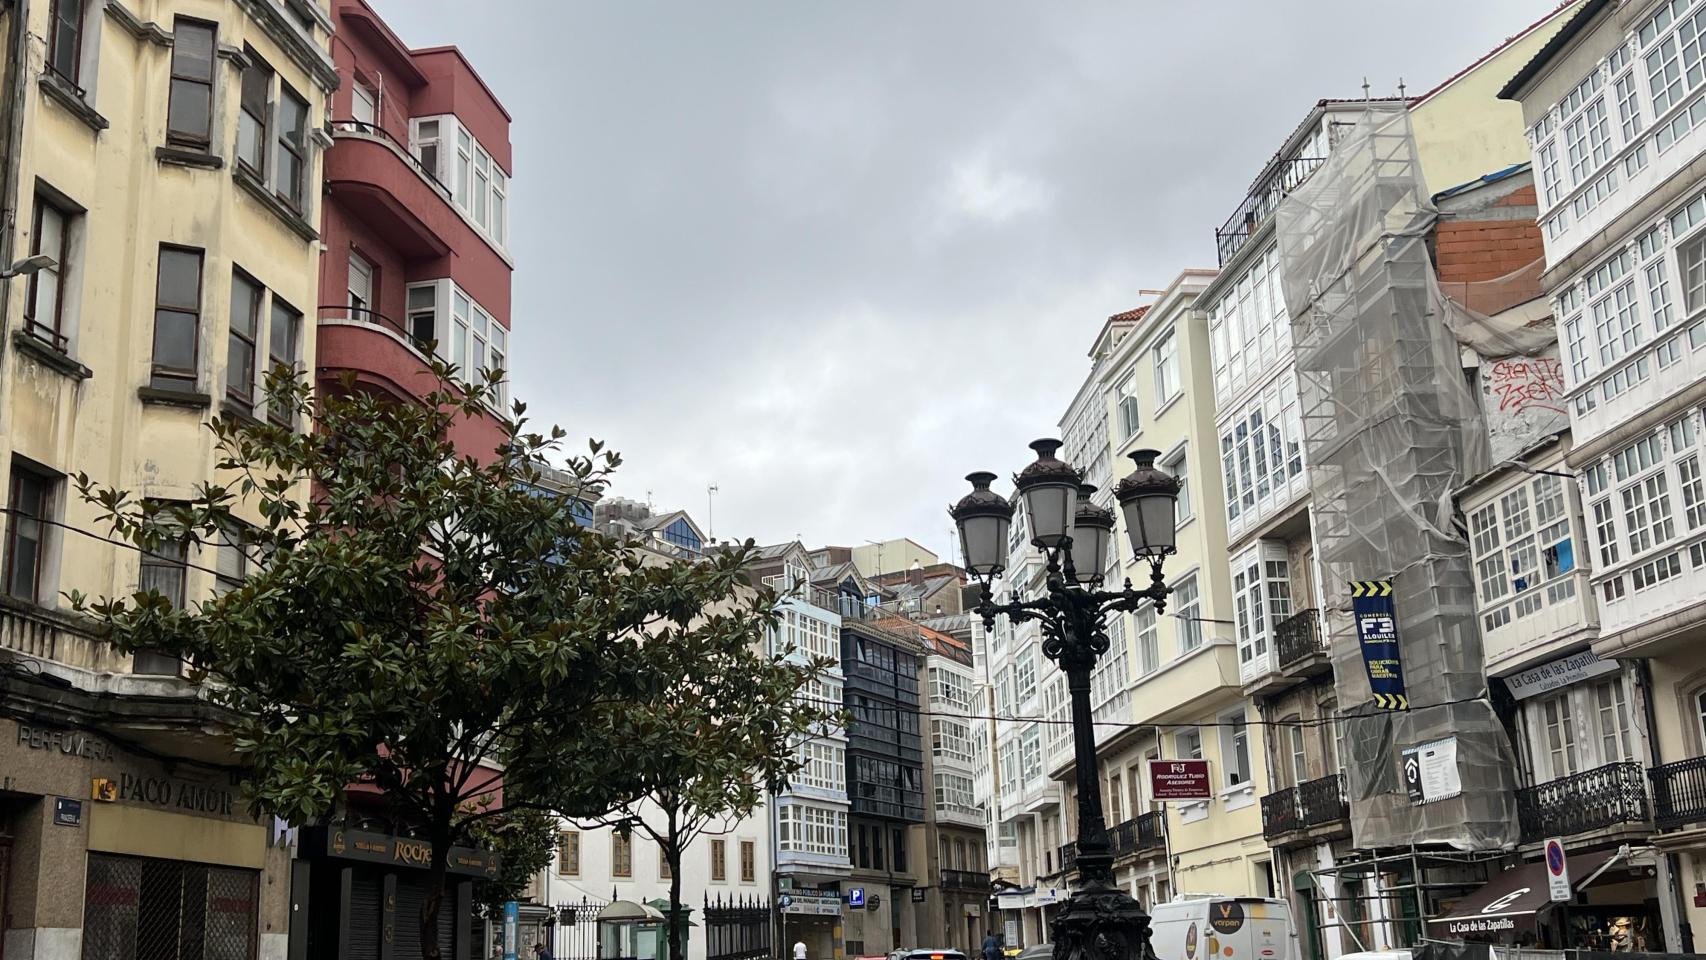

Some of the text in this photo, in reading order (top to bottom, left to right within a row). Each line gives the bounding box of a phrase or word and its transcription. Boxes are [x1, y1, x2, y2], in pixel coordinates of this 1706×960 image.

[1361, 617, 1394, 634] F3
[1511, 678, 1522, 689] La
[1521, 673, 1542, 685] Casa
[1541, 666, 1553, 680] de
[1550, 663, 1566, 675] las
[119, 771, 172, 806] PACO
[852, 889, 860, 901] P
[1449, 918, 1515, 933] La Casa de las Zapatillas
